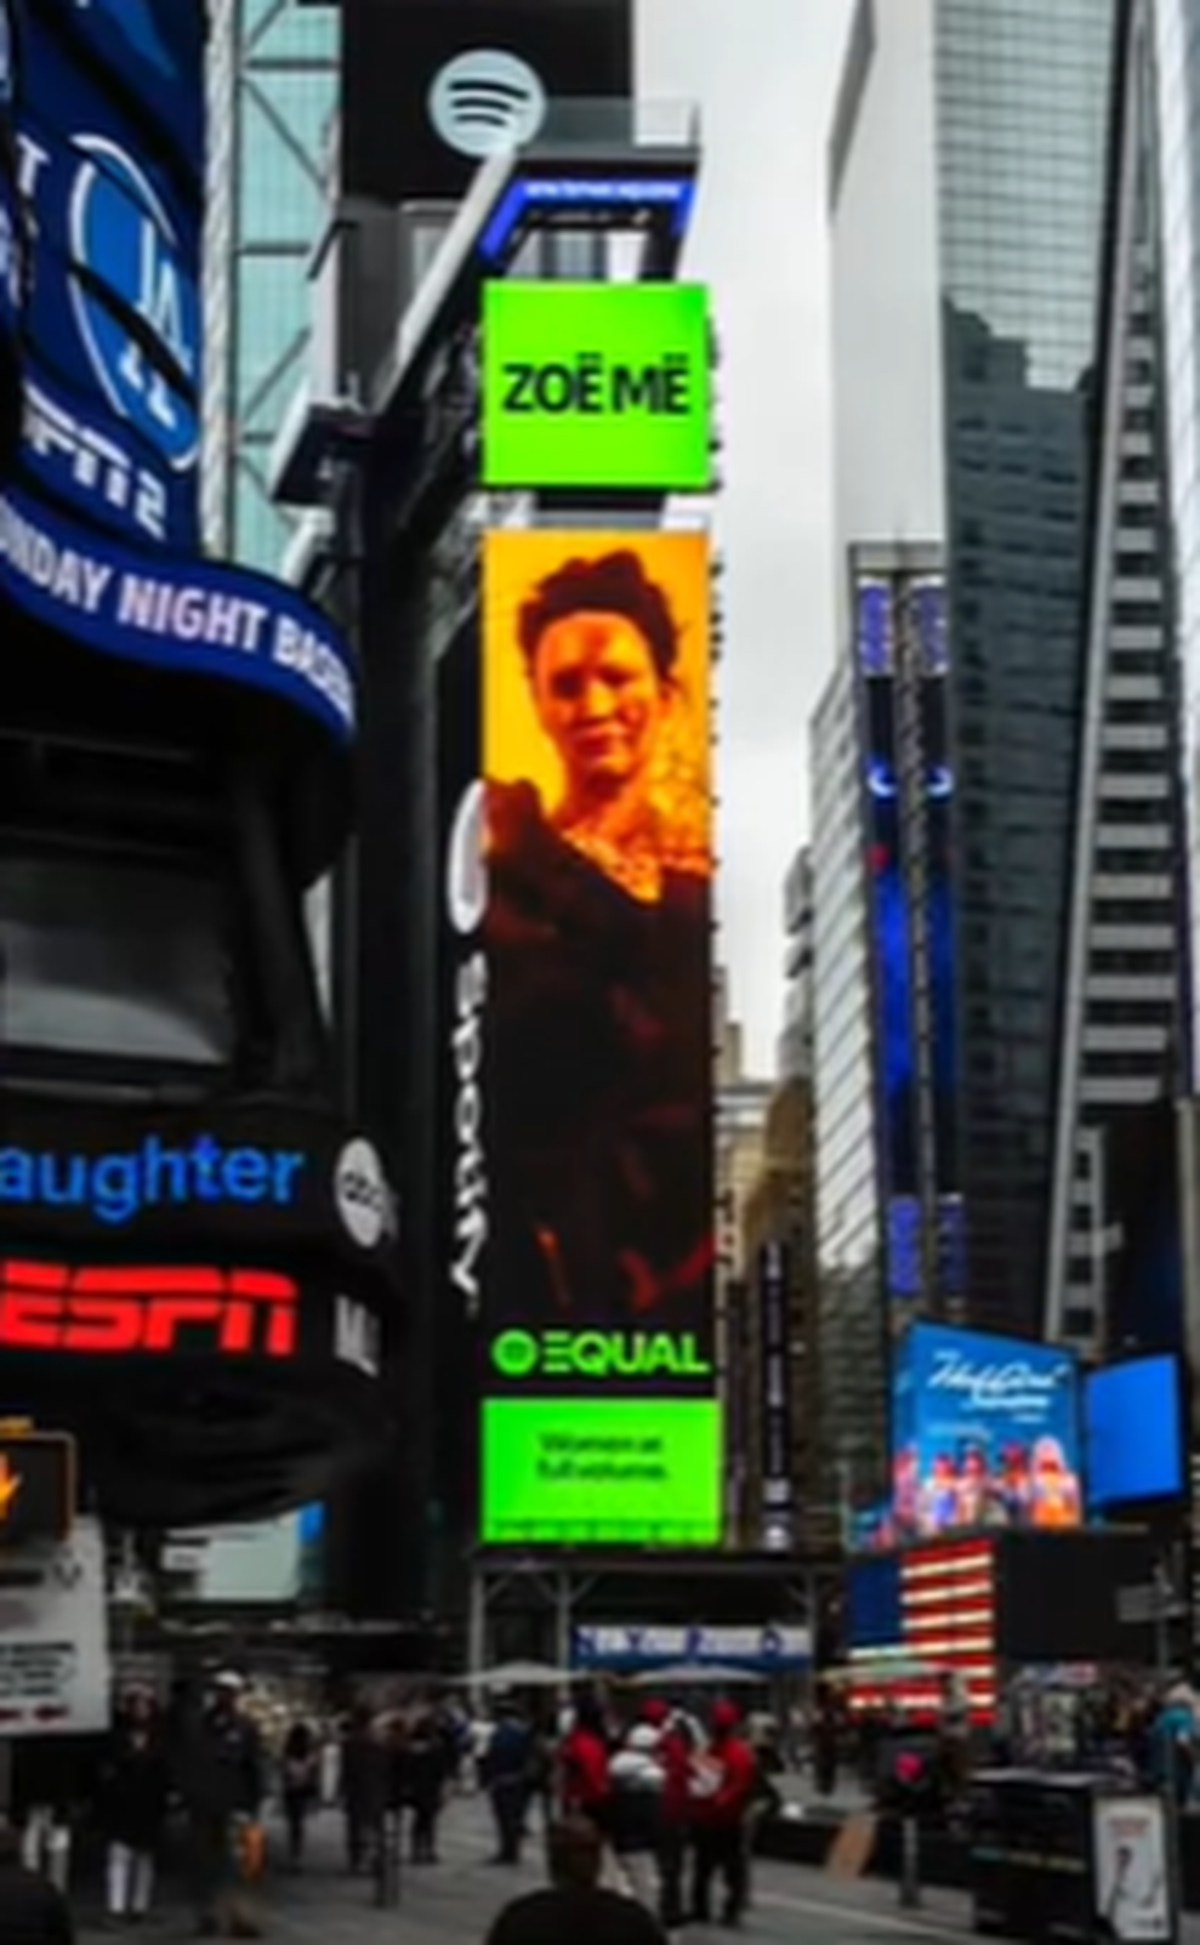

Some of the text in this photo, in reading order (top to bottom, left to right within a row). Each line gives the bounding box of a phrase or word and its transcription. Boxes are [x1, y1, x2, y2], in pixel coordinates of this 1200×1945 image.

[502, 351, 691, 416] ZOË MË
[117, 572, 269, 652] NIGHT
[0, 1132, 305, 1226] aughter
[0, 1258, 299, 1357] ESPN
[542, 1330, 710, 1375] EQUAL
